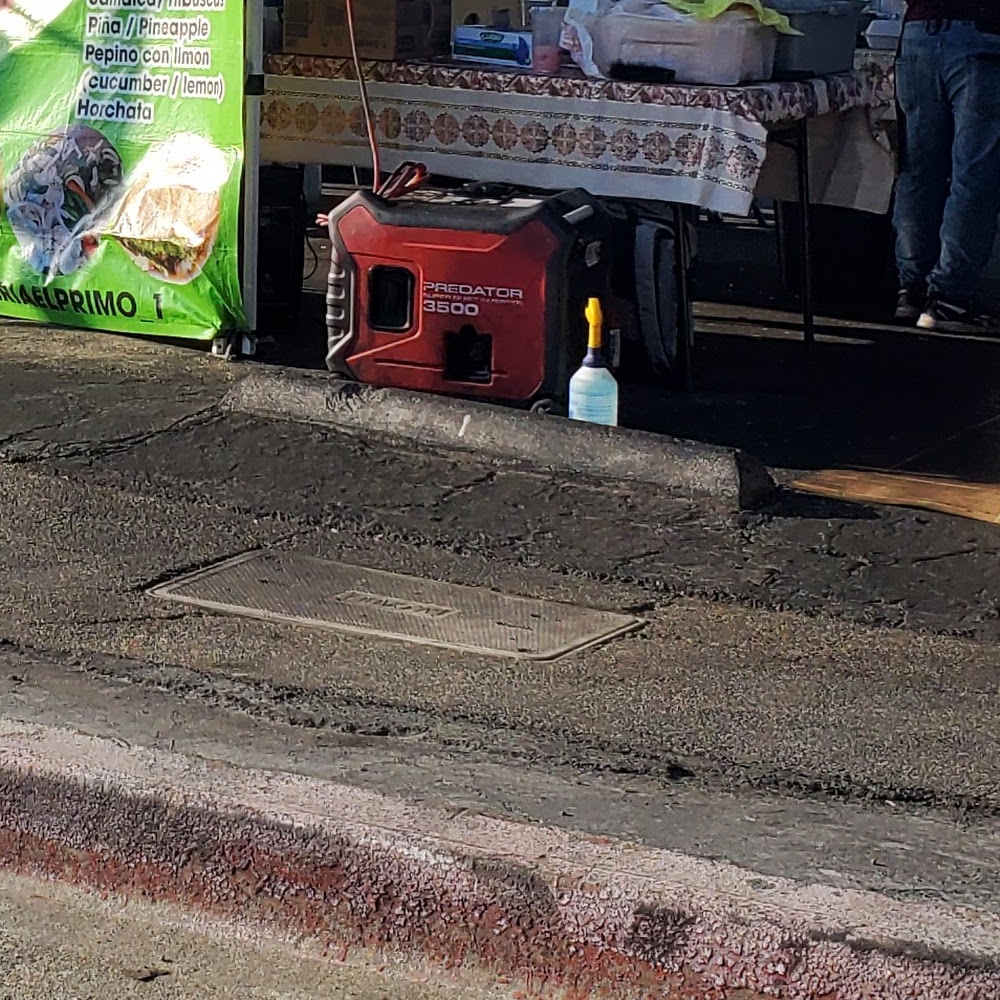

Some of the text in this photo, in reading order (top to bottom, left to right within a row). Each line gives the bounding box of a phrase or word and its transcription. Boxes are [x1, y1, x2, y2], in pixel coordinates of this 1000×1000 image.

[88, 16, 121, 34] Piña
[139, 16, 209, 40] Pineapple
[85, 44, 210, 66] Pepino con limon
[83, 70, 167, 94] (cucumber
[183, 73, 223, 98] lemon)
[77, 98, 152, 120] Horchata
[422, 281, 523, 299] PREDATOR
[422, 300, 479, 316] 3500
